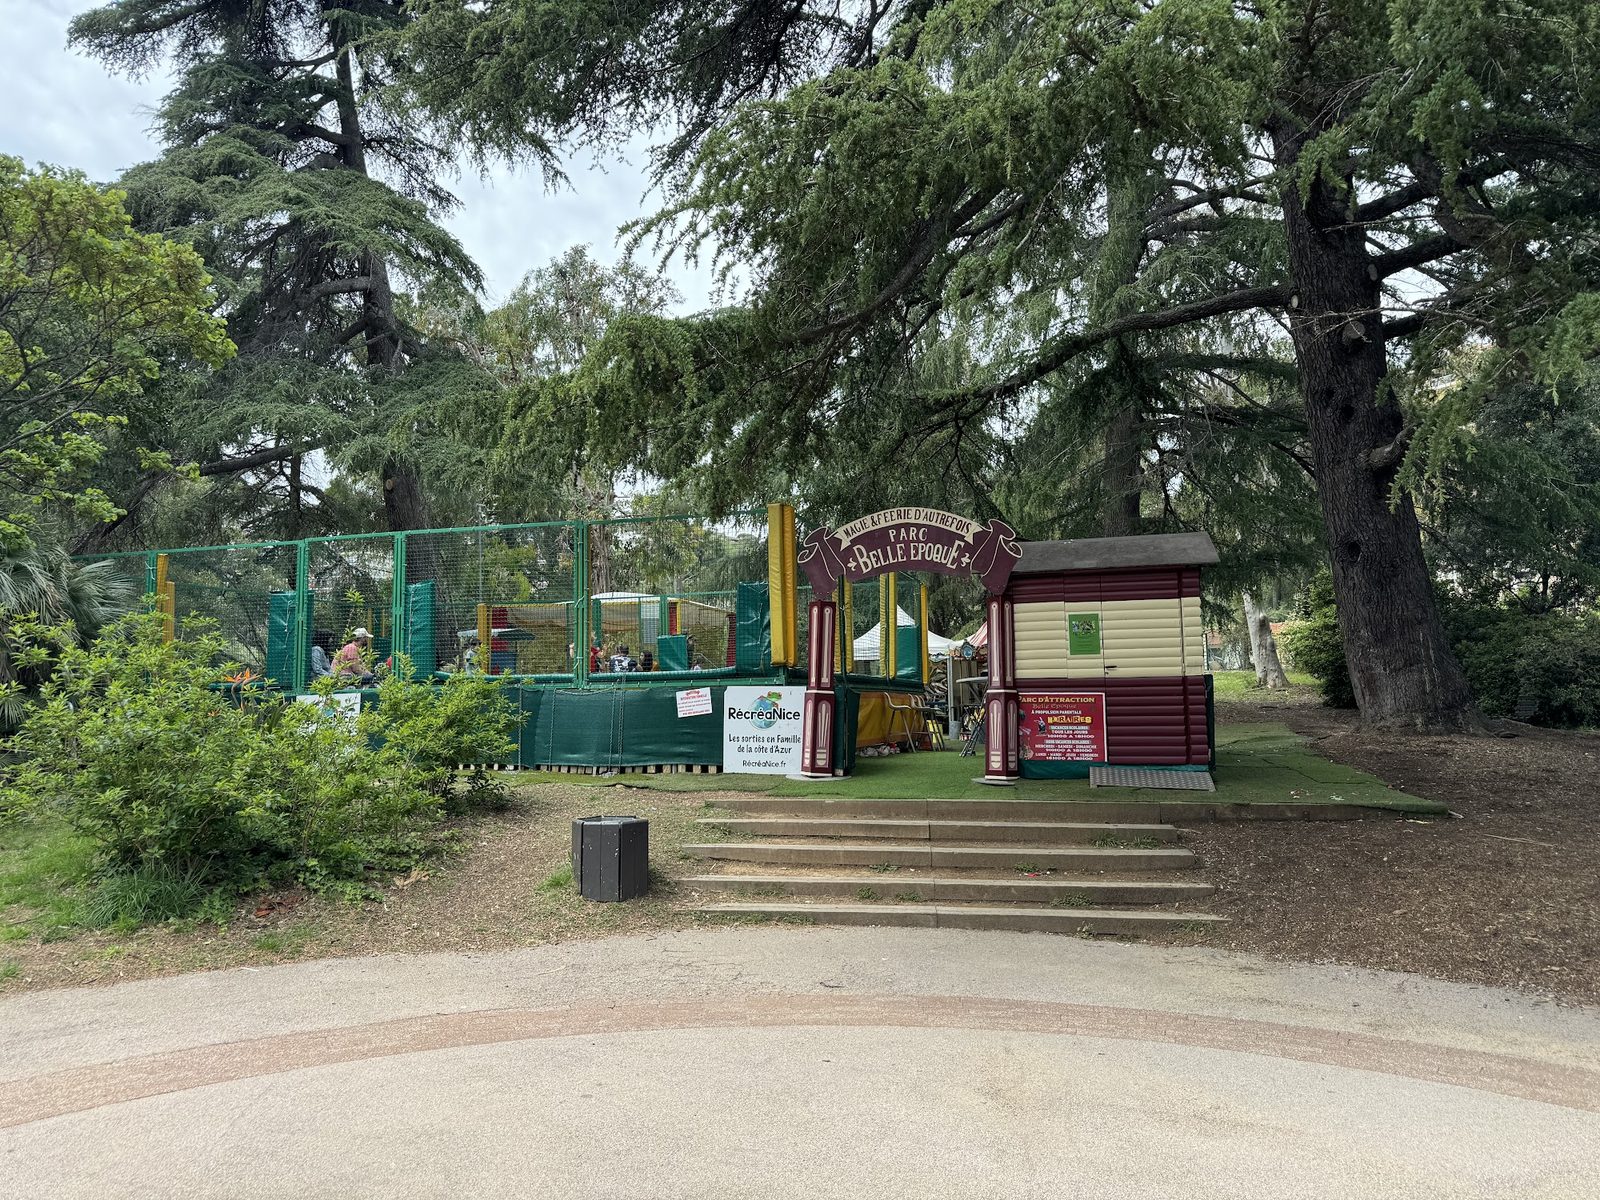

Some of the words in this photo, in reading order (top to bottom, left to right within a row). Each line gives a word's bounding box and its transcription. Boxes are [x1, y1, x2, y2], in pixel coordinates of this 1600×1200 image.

[843, 518, 870, 539] MAGIE
[914, 508, 972, 534] D'AUTREFOIS
[888, 527, 928, 543] PARC
[852, 543, 907, 574] BELLE
[910, 539, 965, 570] EPOQUE
[728, 707, 800, 720] RécréaNice
[729, 734, 740, 743] Les
[741, 734, 765, 743] sorties
[776, 734, 801, 744] Famille
[737, 745, 744, 753] de
[746, 745, 752, 753] la
[754, 745, 768, 753] côte
[769, 745, 792, 754] d'Azur
